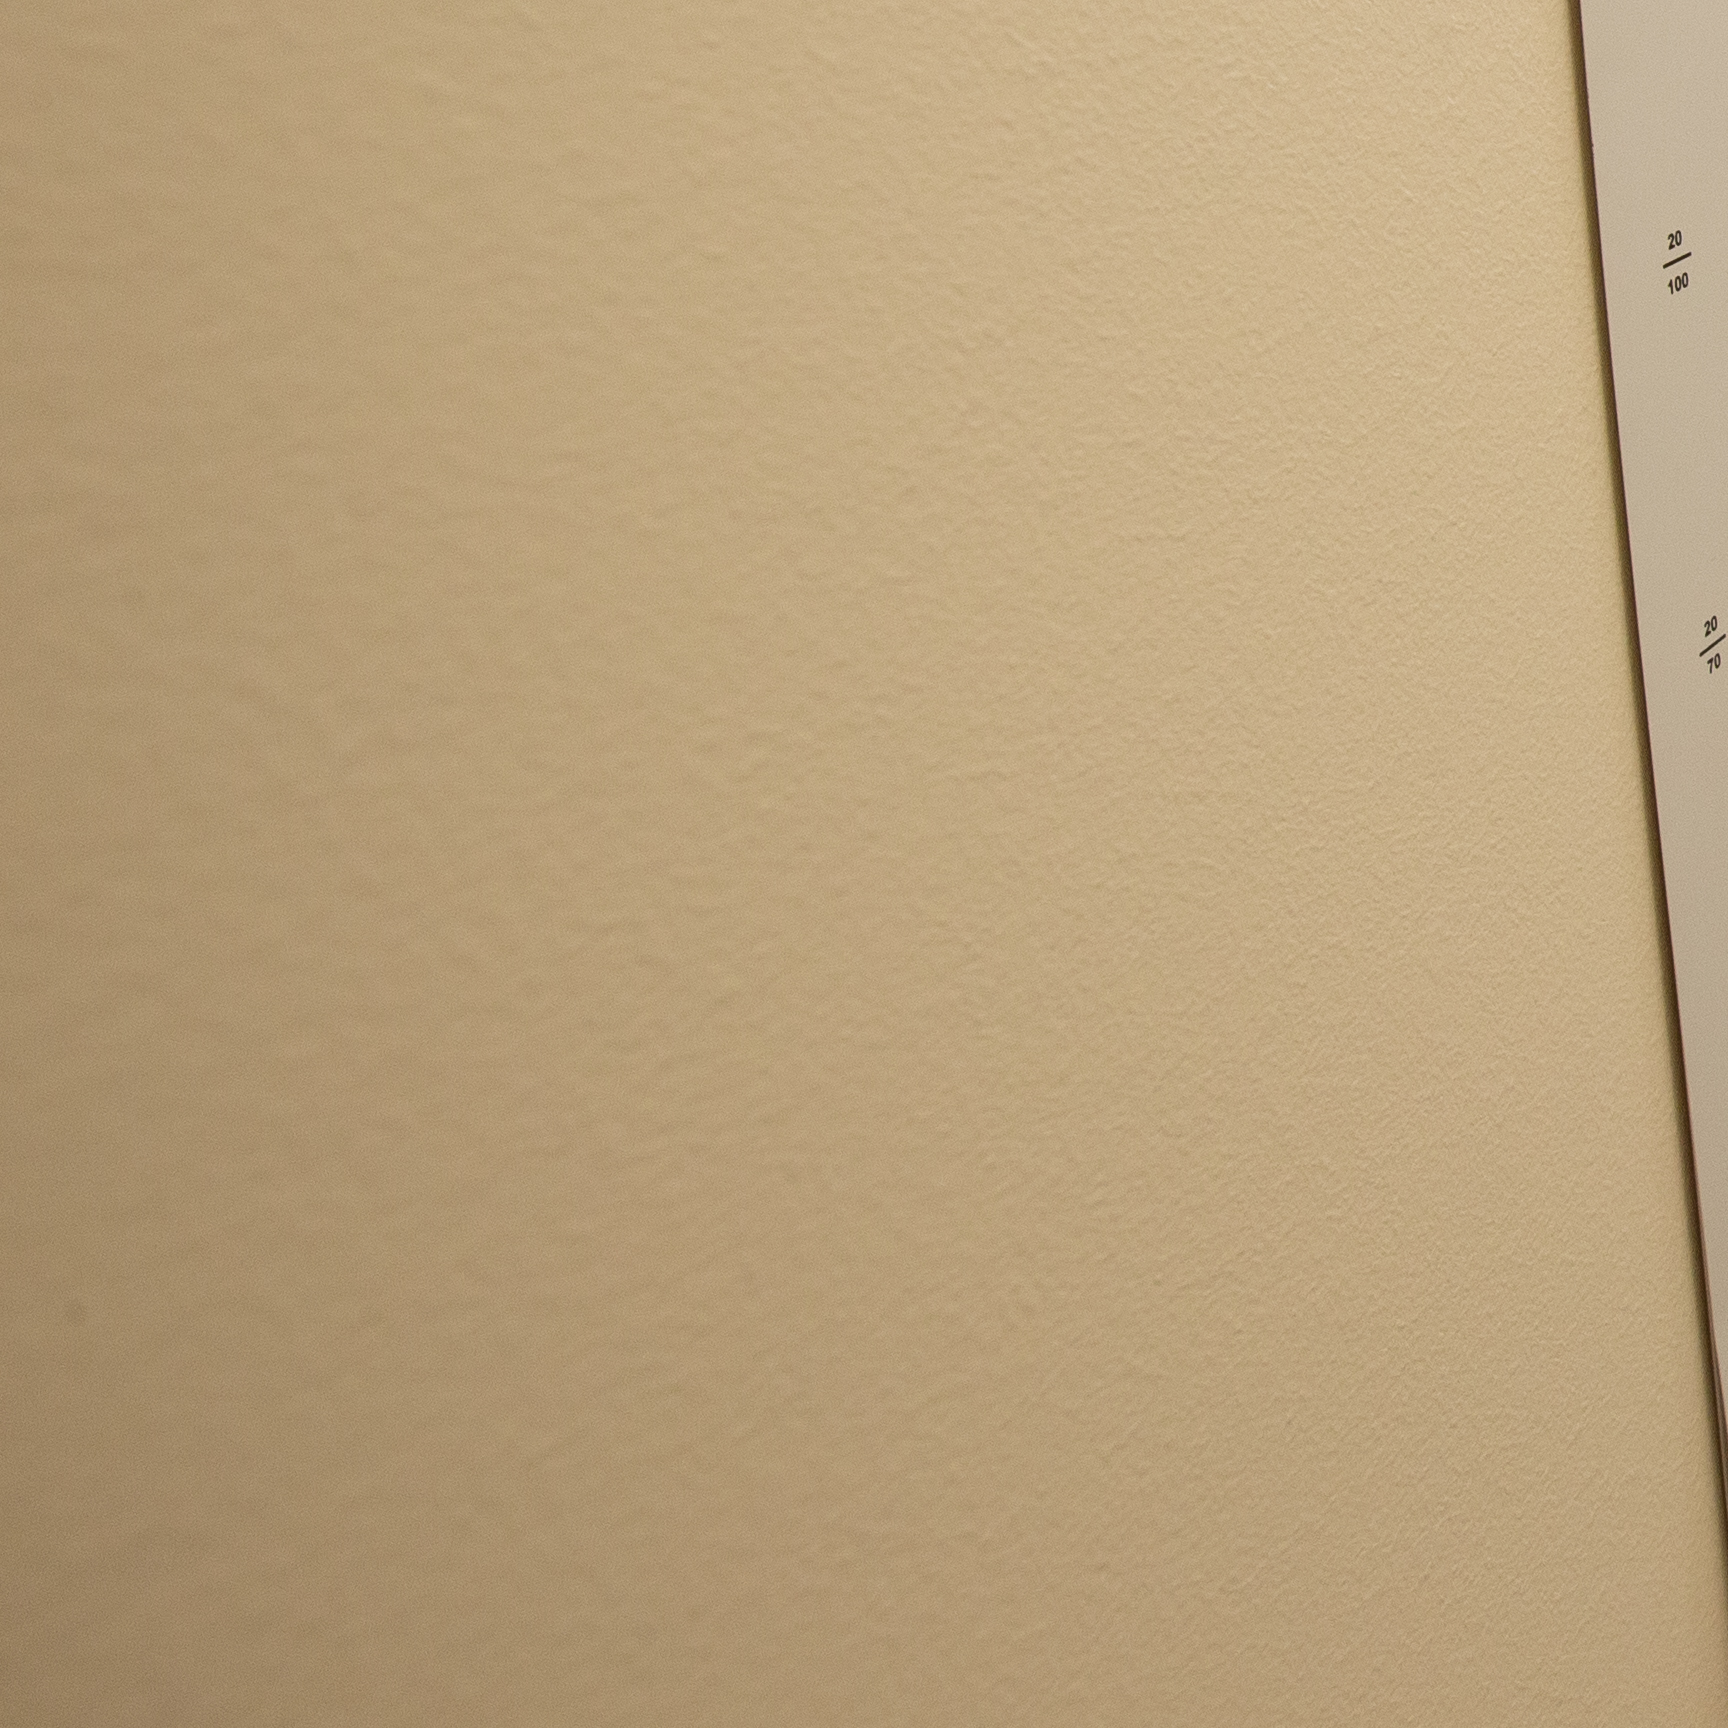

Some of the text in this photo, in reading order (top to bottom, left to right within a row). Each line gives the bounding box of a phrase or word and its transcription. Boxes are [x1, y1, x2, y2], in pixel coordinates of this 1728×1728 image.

[1667, 230, 1682, 250] 20
[1667, 272, 1689, 295] 100
[1704, 615, 1718, 637] 20
[1706, 652, 1721, 673] 70
